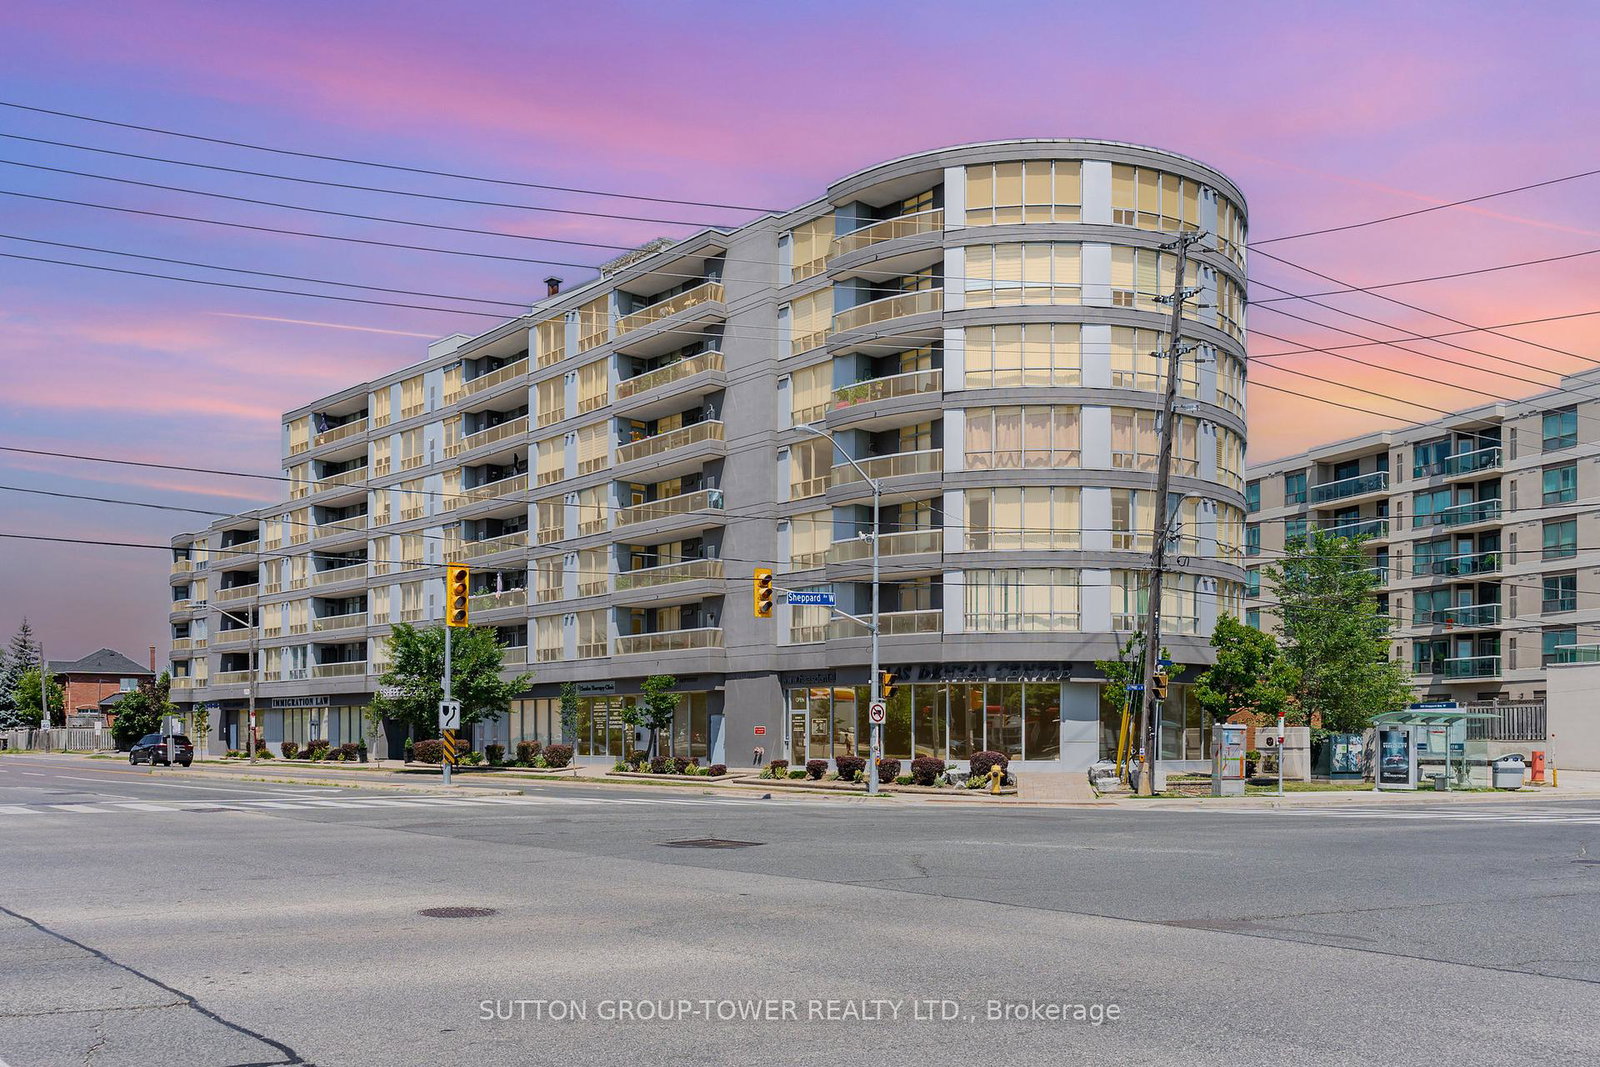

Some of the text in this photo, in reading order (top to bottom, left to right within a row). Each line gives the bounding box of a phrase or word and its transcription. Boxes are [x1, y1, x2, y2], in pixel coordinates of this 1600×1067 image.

[788, 593, 821, 603] Sheppard
[828, 594, 835, 602] W
[272, 696, 329, 707] IMMIGRATION LAW
